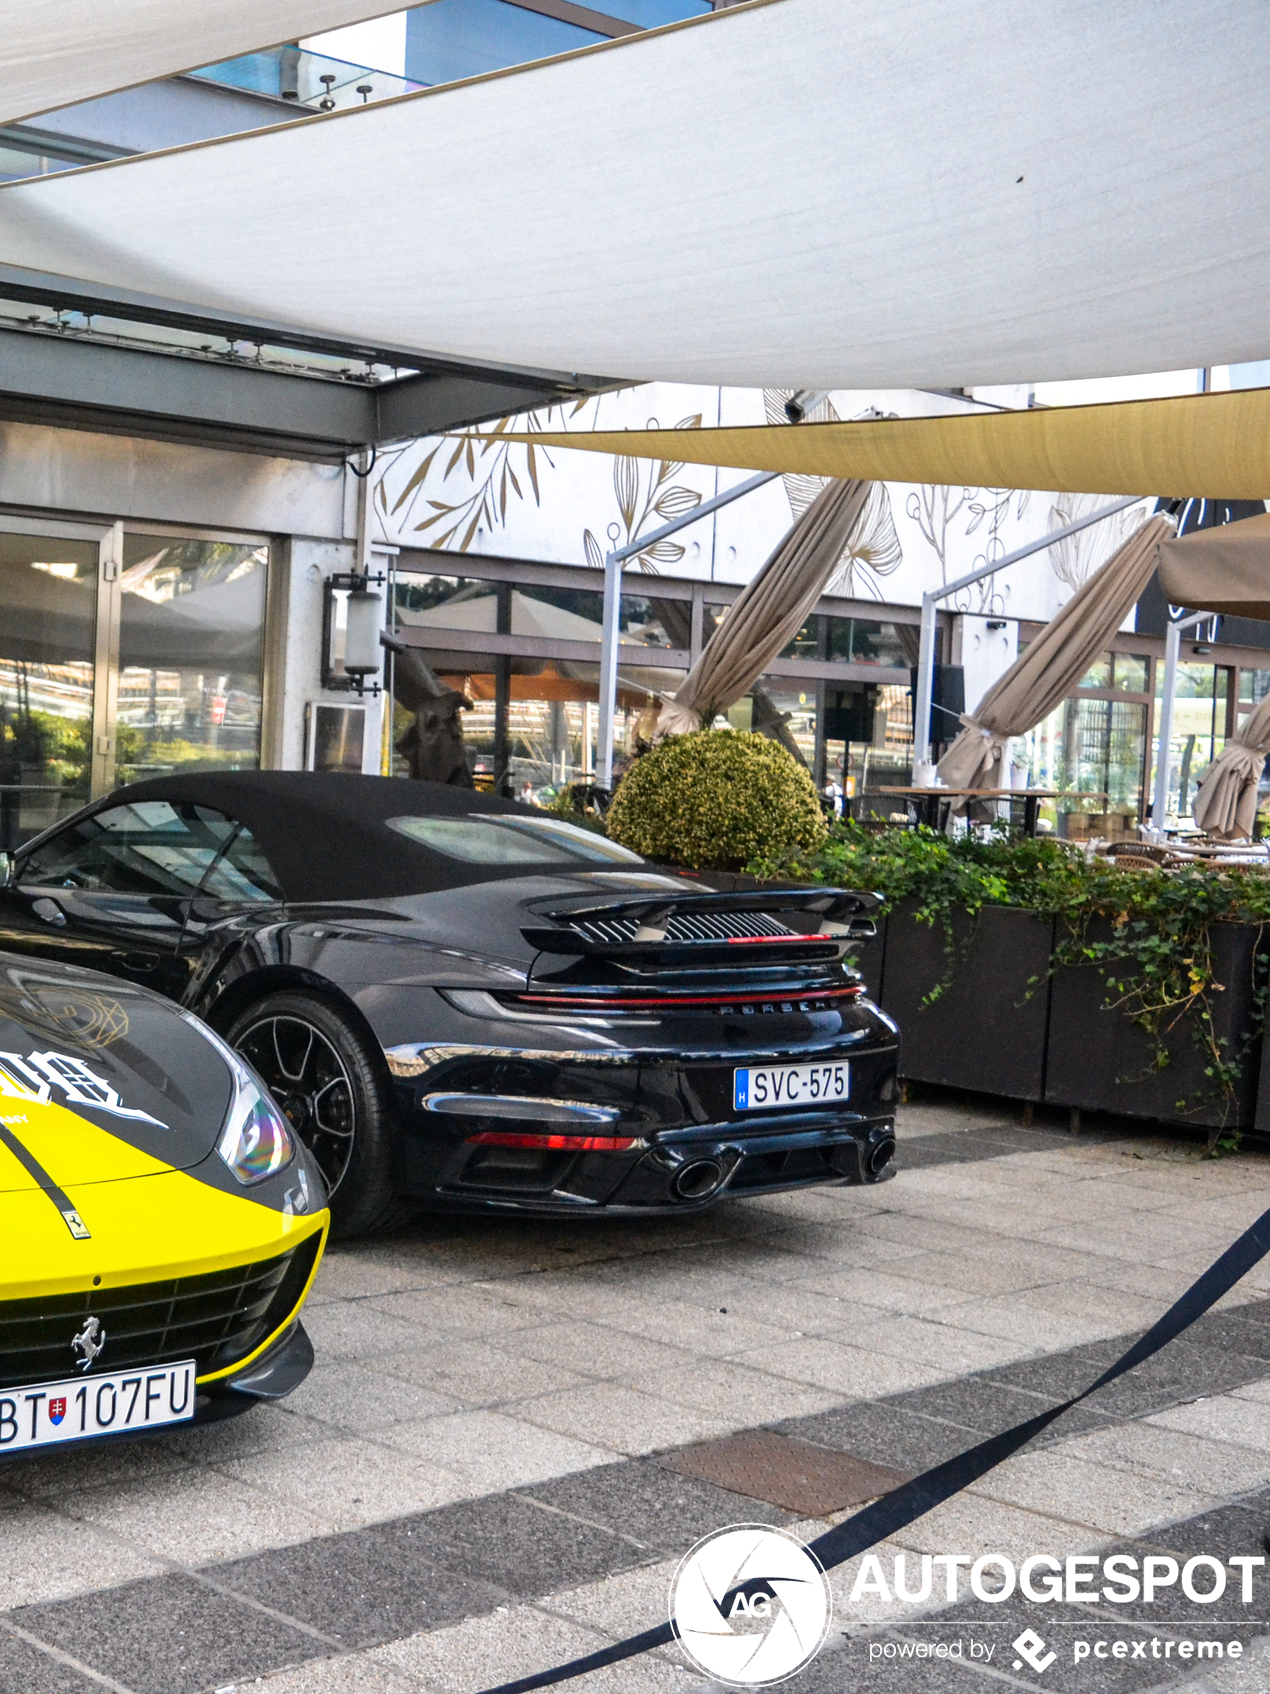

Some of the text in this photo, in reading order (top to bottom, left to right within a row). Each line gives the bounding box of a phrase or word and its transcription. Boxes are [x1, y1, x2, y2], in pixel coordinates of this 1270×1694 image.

[719, 1000, 839, 1016] PORSCHE
[738, 1066, 845, 1103] H SVC-575
[74, 1368, 190, 1431] 107FU
